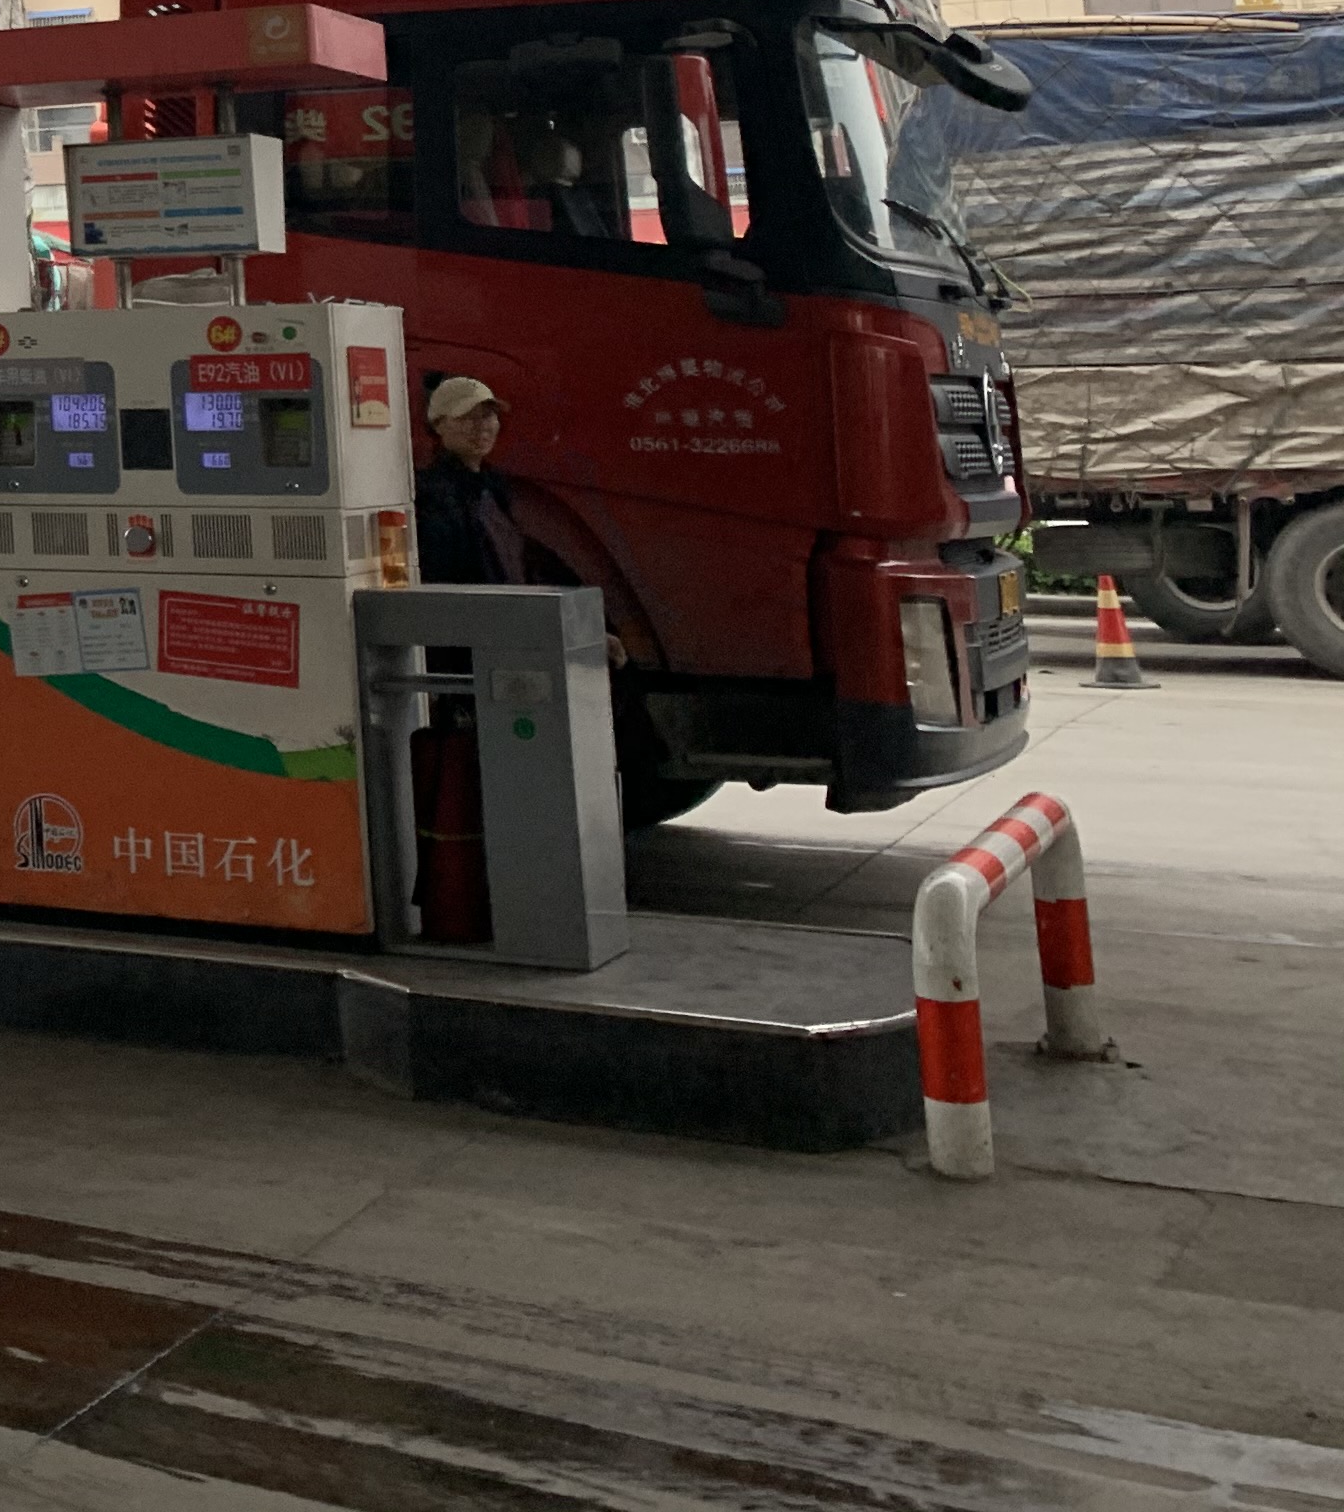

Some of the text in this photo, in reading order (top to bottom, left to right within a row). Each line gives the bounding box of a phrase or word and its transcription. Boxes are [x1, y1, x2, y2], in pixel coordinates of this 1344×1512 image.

[210, 324, 237, 345] 6#
[113, 826, 315, 887] 中国石化
